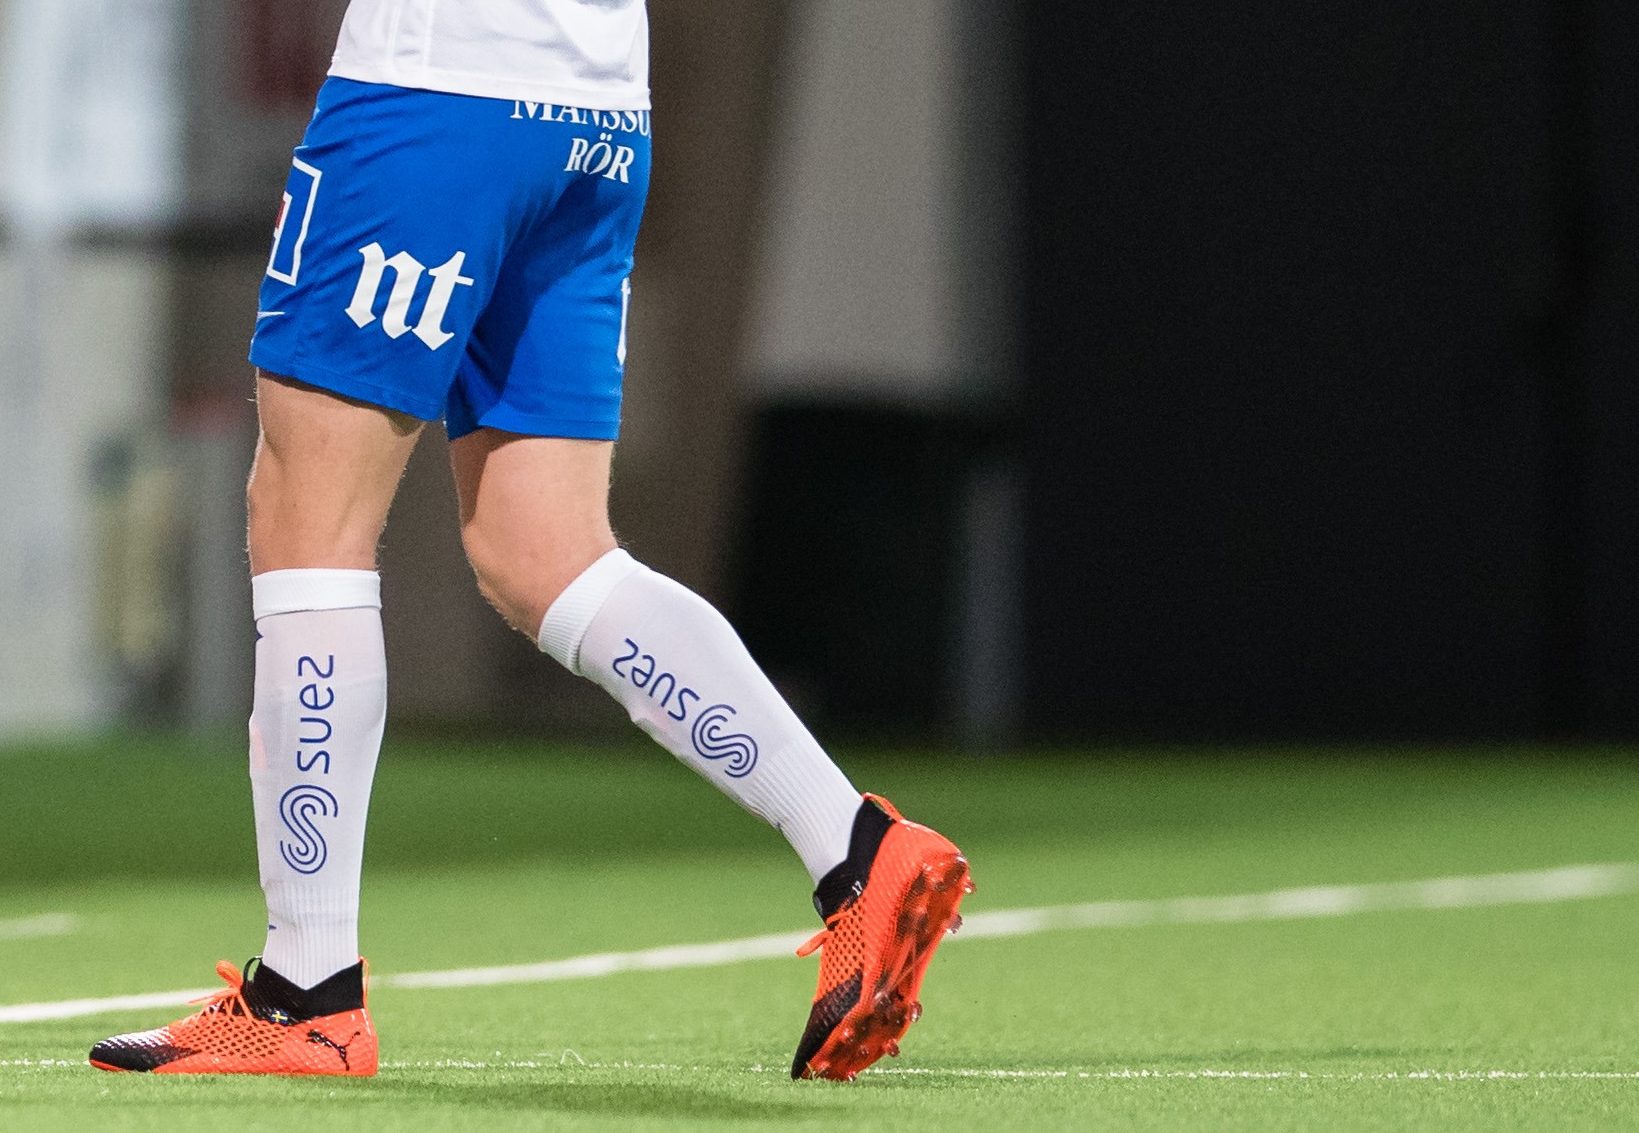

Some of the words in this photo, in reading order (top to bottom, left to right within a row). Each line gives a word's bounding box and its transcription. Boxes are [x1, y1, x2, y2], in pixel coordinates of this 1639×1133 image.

[563, 133, 635, 183] RÖR
[345, 241, 474, 351] nt
[297, 654, 335, 774] suez
[611, 637, 700, 723] suez
